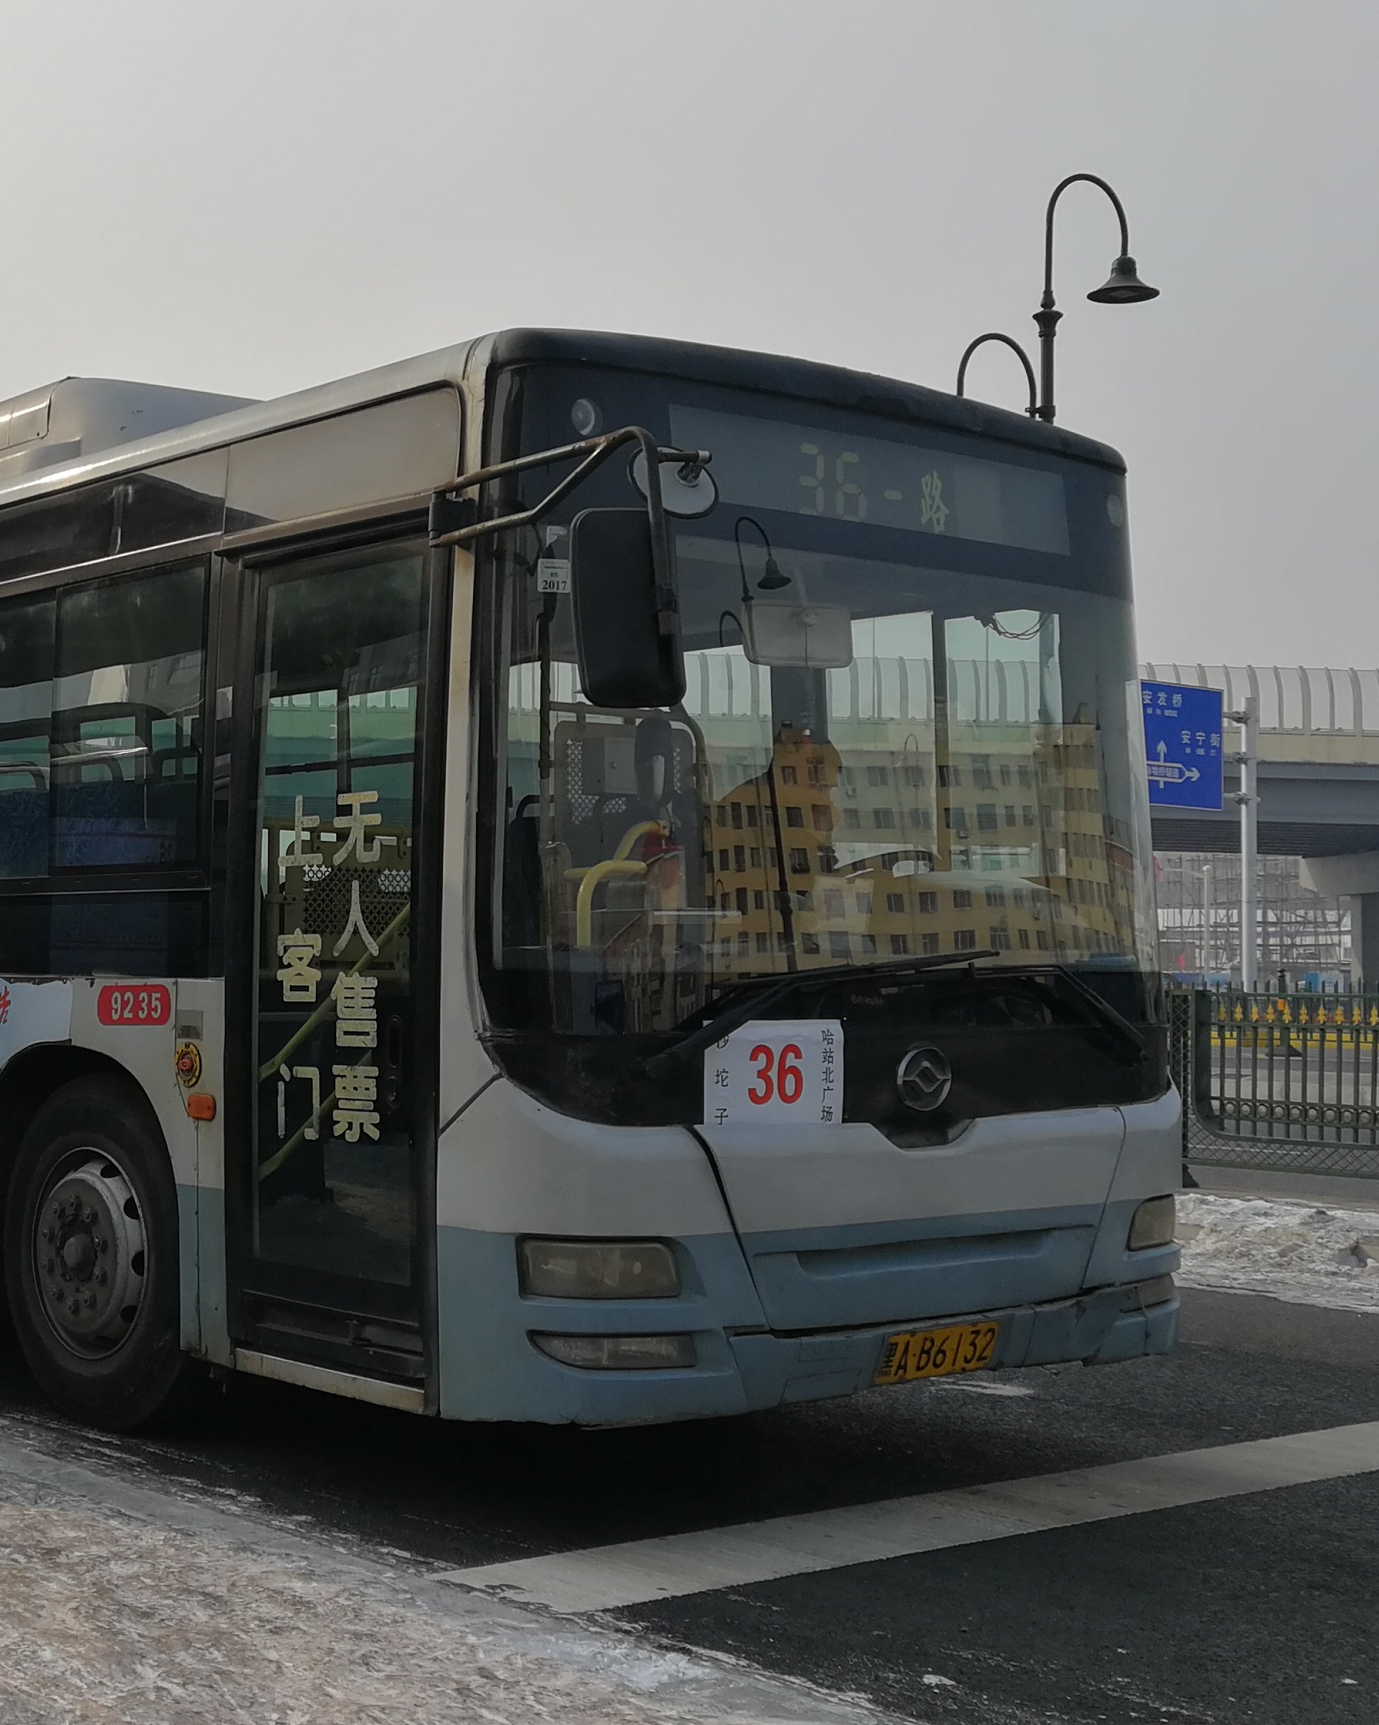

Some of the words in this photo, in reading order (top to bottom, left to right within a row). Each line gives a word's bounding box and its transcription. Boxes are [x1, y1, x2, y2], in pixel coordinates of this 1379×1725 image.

[542, 580, 567, 591] 2017
[1181, 730, 1221, 748] 安宁街
[276, 794, 323, 1141] 上客门
[331, 790, 382, 1143] 无人售票
[110, 991, 162, 1020] 9235
[747, 1043, 804, 1106] 36
[820, 1028, 835, 1122] 哈站北广场
